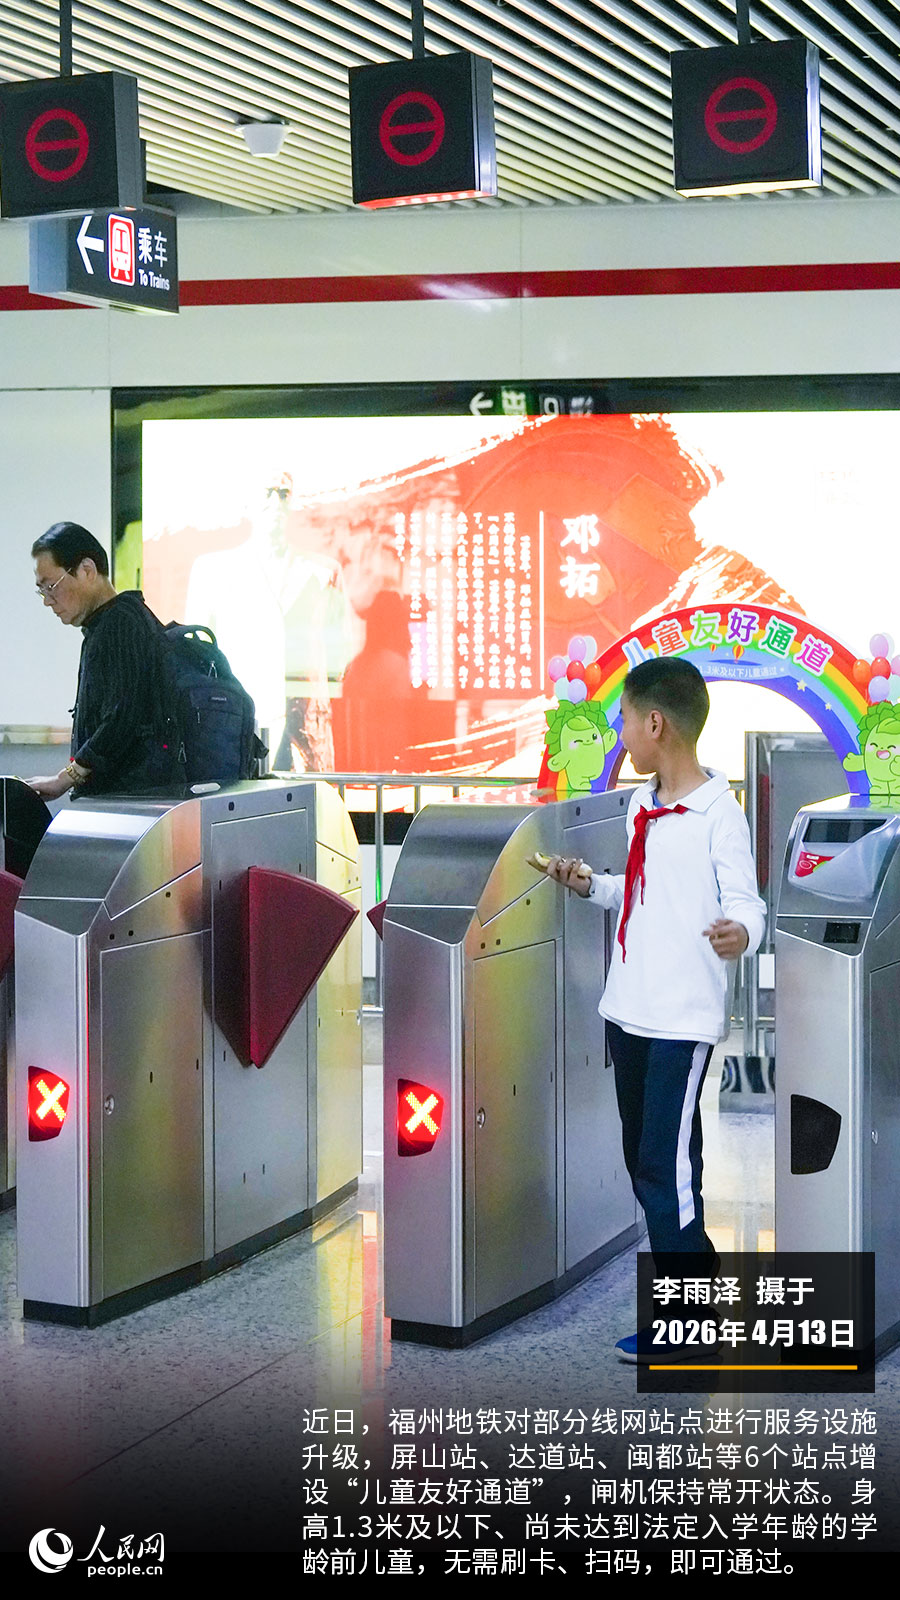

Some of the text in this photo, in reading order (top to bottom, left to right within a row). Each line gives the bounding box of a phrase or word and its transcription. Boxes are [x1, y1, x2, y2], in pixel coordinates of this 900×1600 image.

[138, 227, 168, 268] 乘车
[139, 269, 170, 291] To Trains
[560, 514, 600, 598] 邓拓
[624, 611, 832, 674] 儿童友好通道
